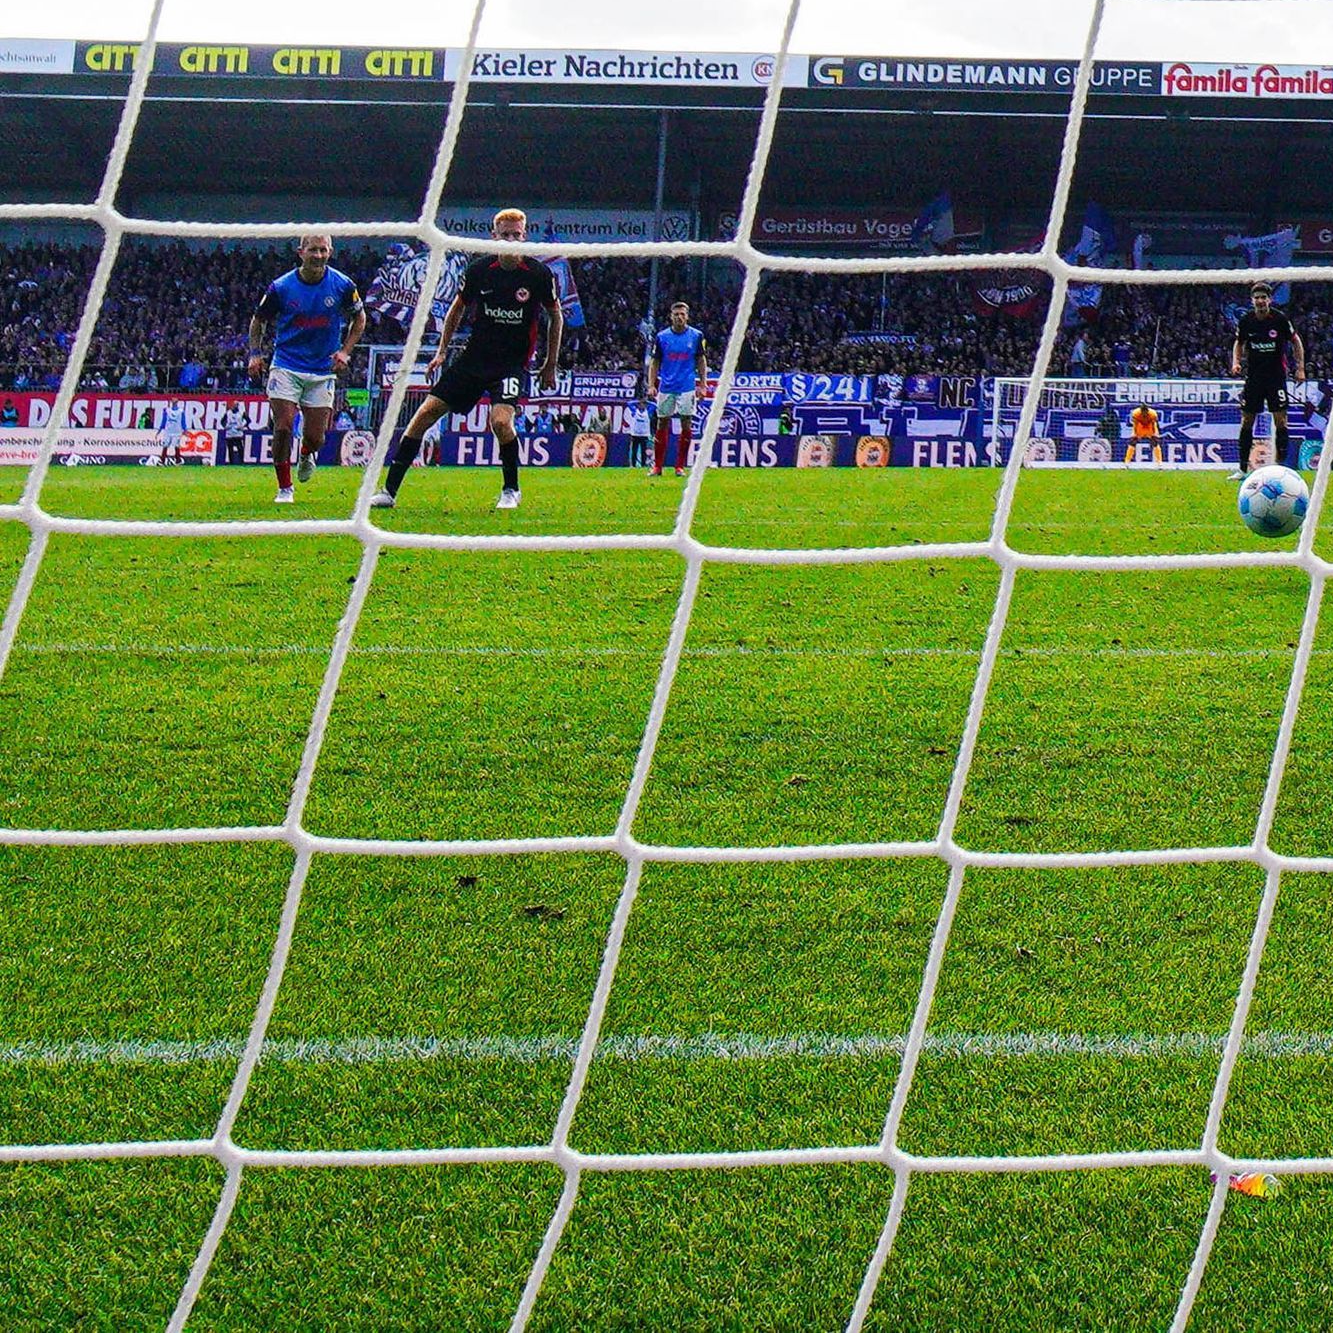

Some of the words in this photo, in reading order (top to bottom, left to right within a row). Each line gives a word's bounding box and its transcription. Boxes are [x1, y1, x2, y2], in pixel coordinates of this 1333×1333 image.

[179, 46, 248, 73] CITTI
[272, 48, 341, 75] CITTI
[365, 50, 433, 76] CITTI
[471, 53, 557, 77] Kieler
[563, 54, 739, 80] Nachrichten
[858, 62, 1046, 86] GLINDEMANN
[1054, 67, 1153, 88] GUPPE
[1164, 63, 1247, 95] famila
[618, 219, 646, 236] Kiel
[762, 218, 857, 234] Gerüstbau
[502, 378, 519, 395] 16
[574, 377, 620, 385] GRUPPO
[816, 376, 868, 401] 241
[573, 388, 635, 398] ERNESTO
[1278, 389, 1287, 402] 9
[28, 398, 88, 428] DS
[60, 454, 106, 465] CASINO
